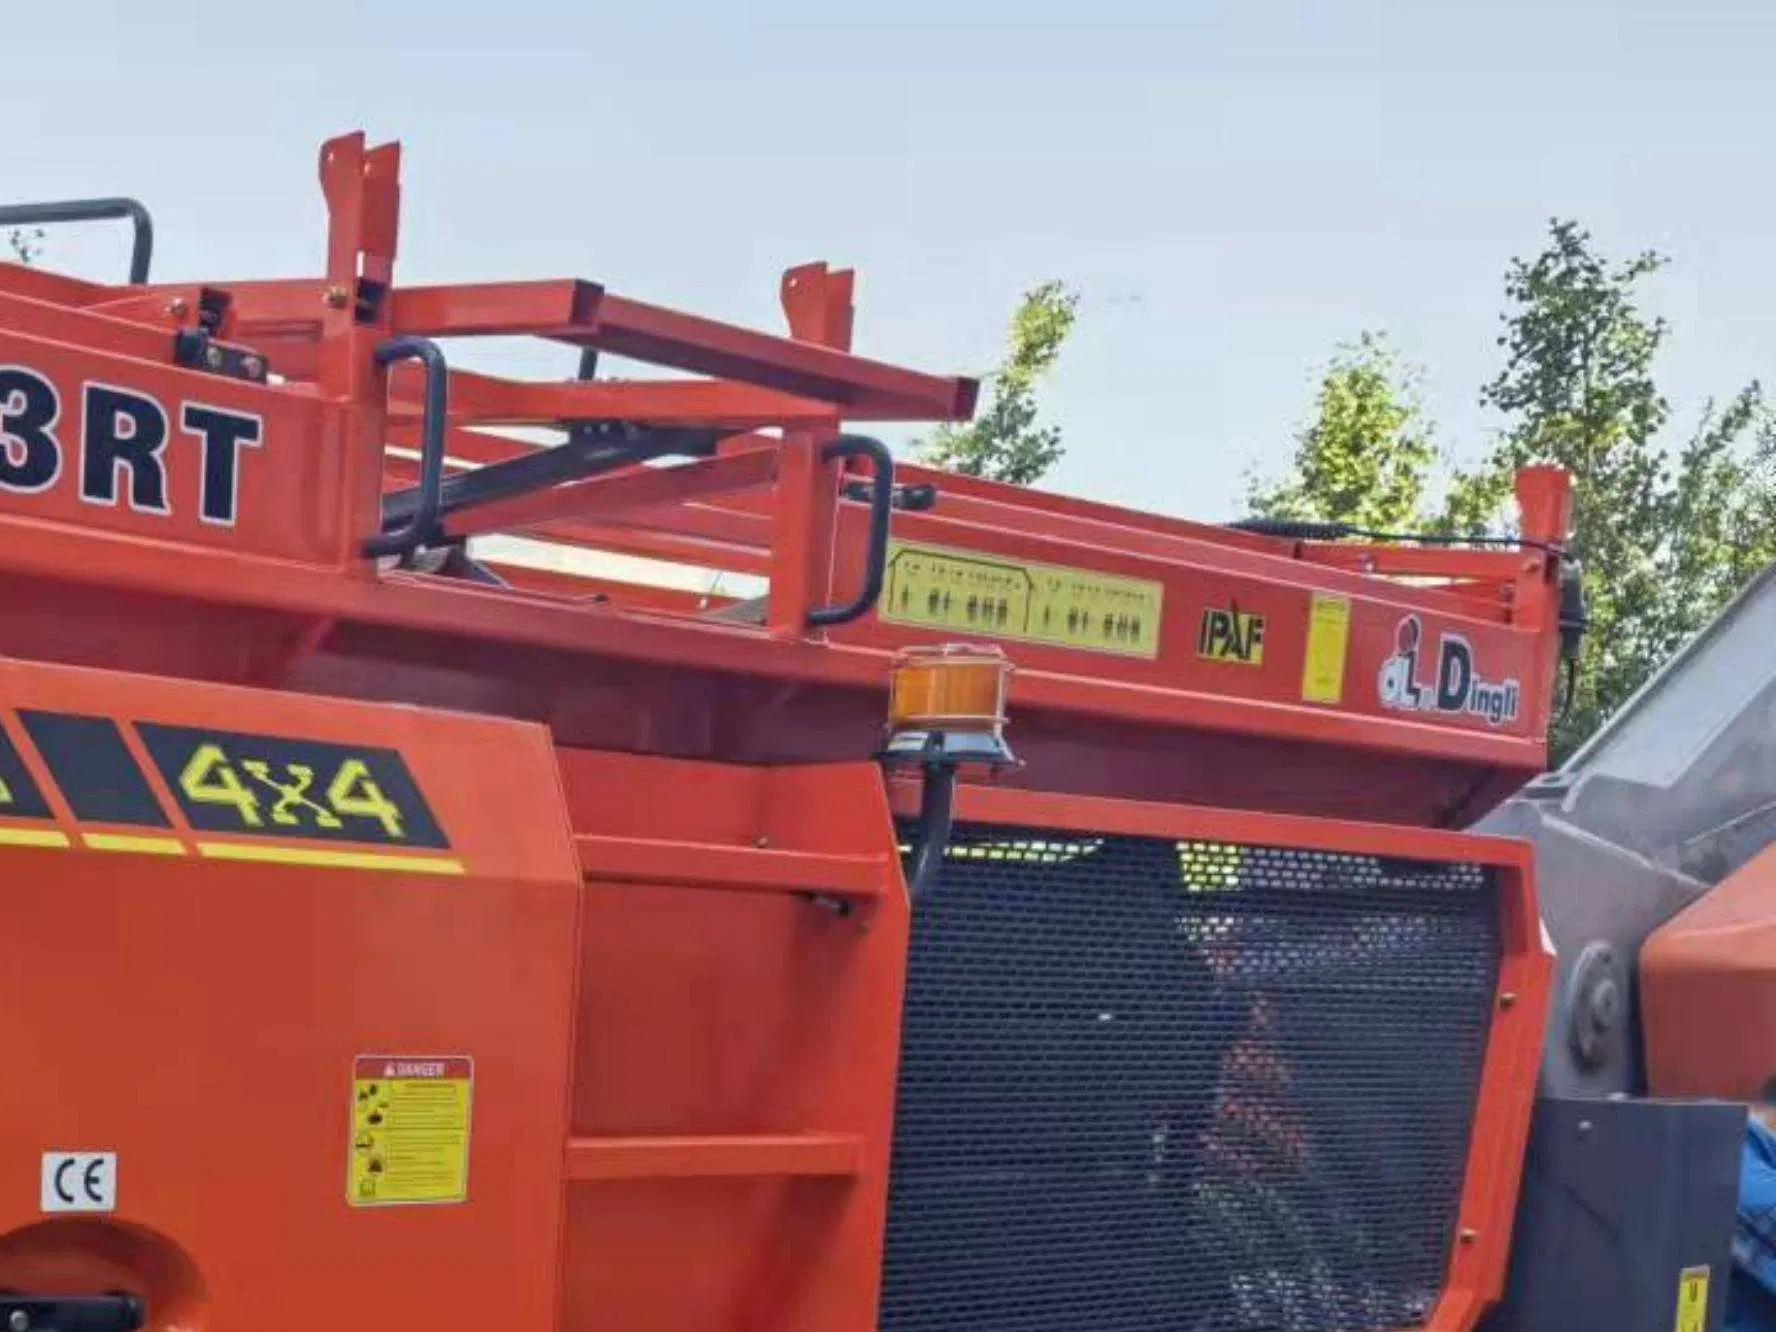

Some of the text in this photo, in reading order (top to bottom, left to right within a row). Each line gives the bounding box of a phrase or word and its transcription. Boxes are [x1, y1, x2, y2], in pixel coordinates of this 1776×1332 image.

[1198, 599, 1265, 661] IPAF
[1436, 632, 1520, 727] Dingli
[54, 1157, 104, 1202] CE
